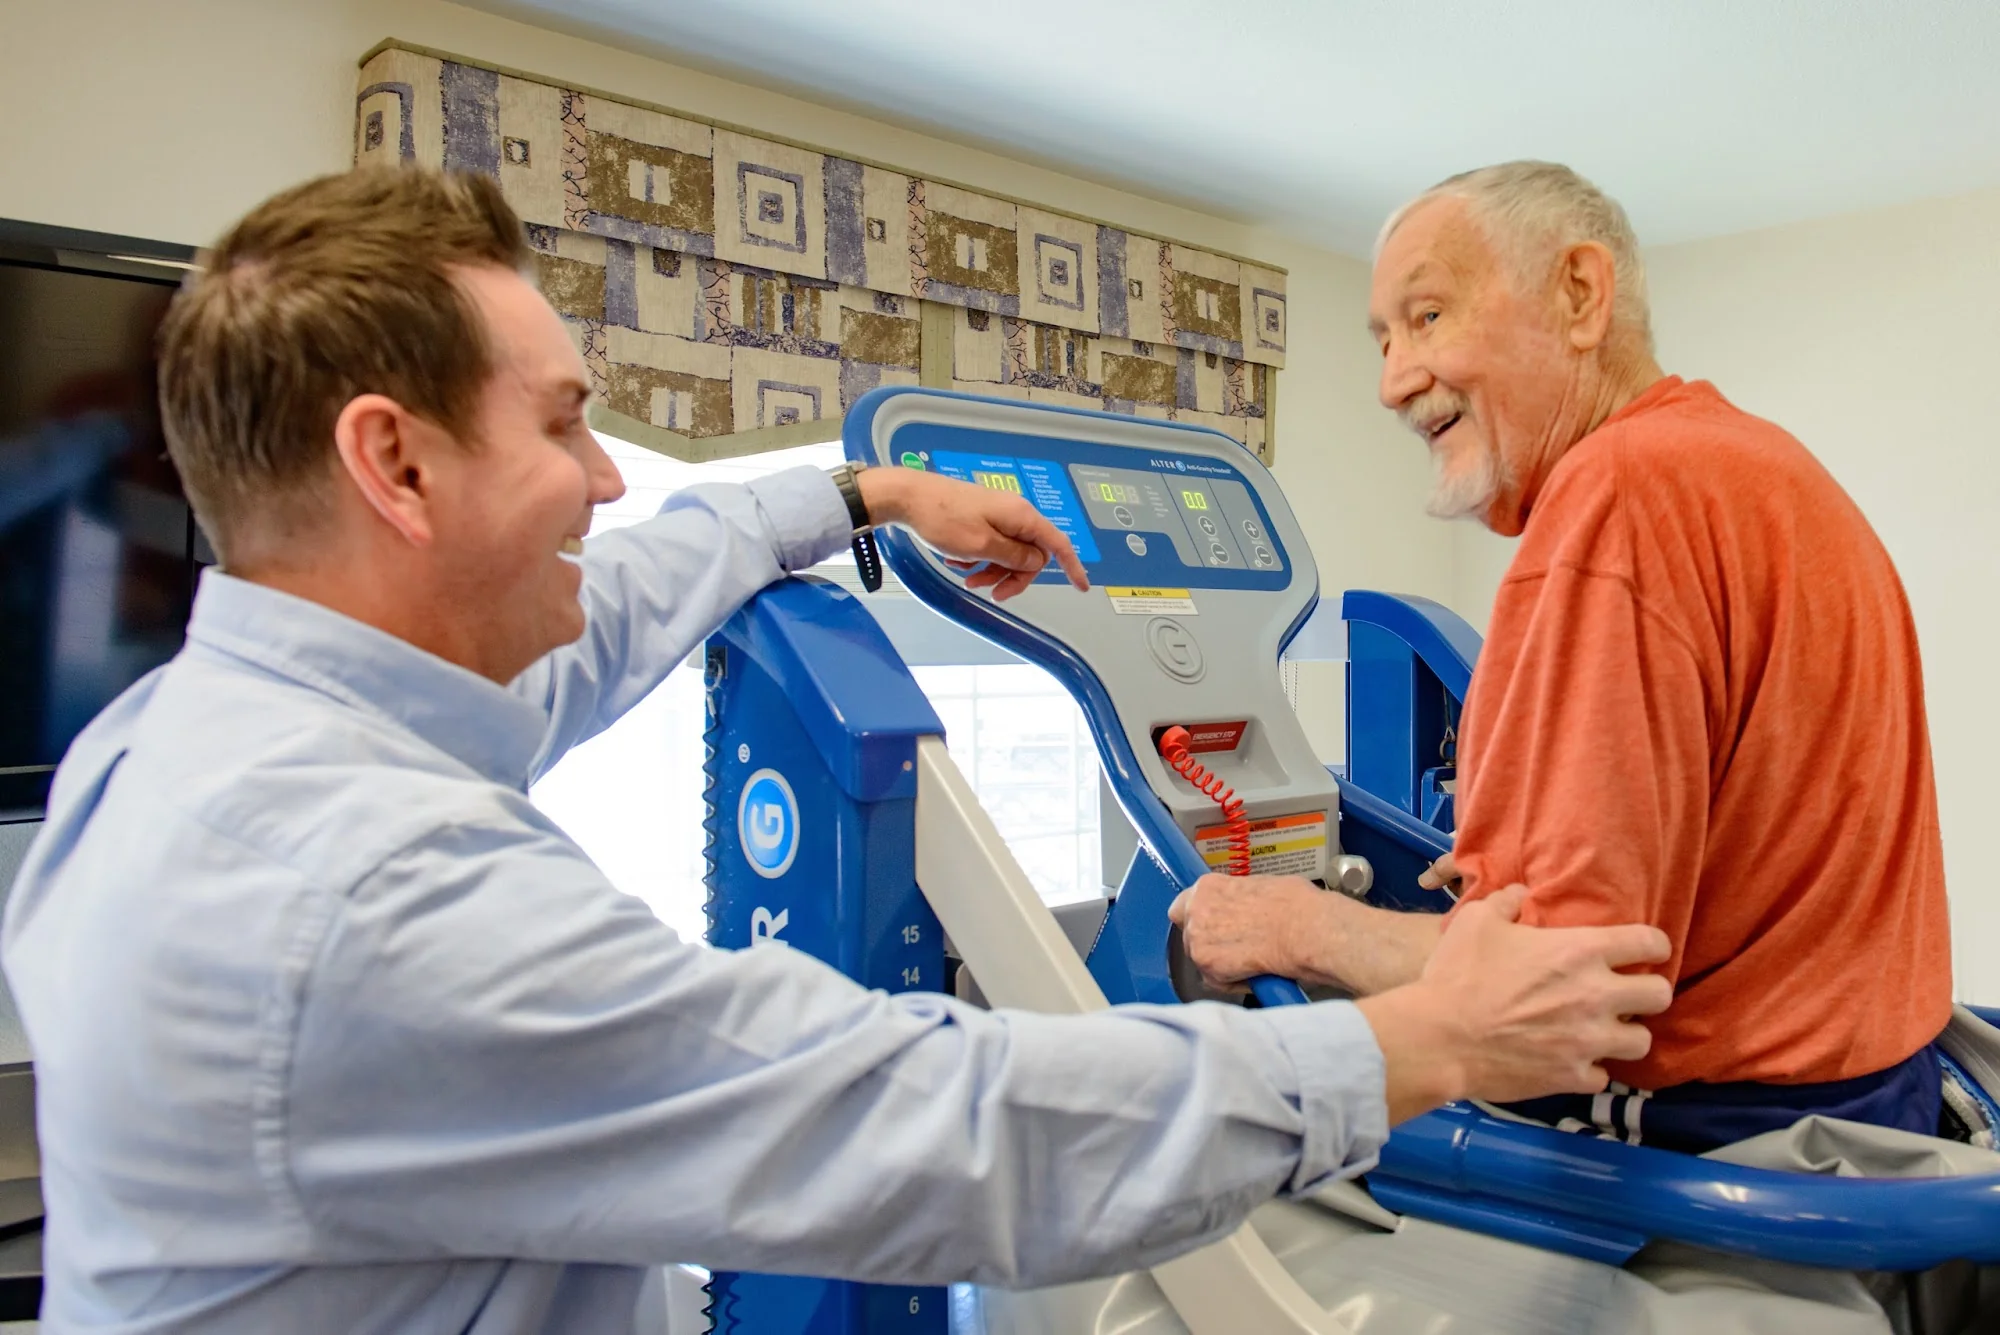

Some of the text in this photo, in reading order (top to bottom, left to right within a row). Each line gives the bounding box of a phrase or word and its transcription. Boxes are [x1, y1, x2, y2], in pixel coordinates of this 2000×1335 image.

[1182, 491, 1207, 510] 0.0
[1137, 589, 1163, 597] CAUTION
[1193, 730, 1236, 740] EMERGENCY STOP
[1256, 844, 1277, 855] CAUTION
[901, 925, 920, 944] 15
[901, 967, 920, 986] 14
[909, 1296, 920, 1315] 6
